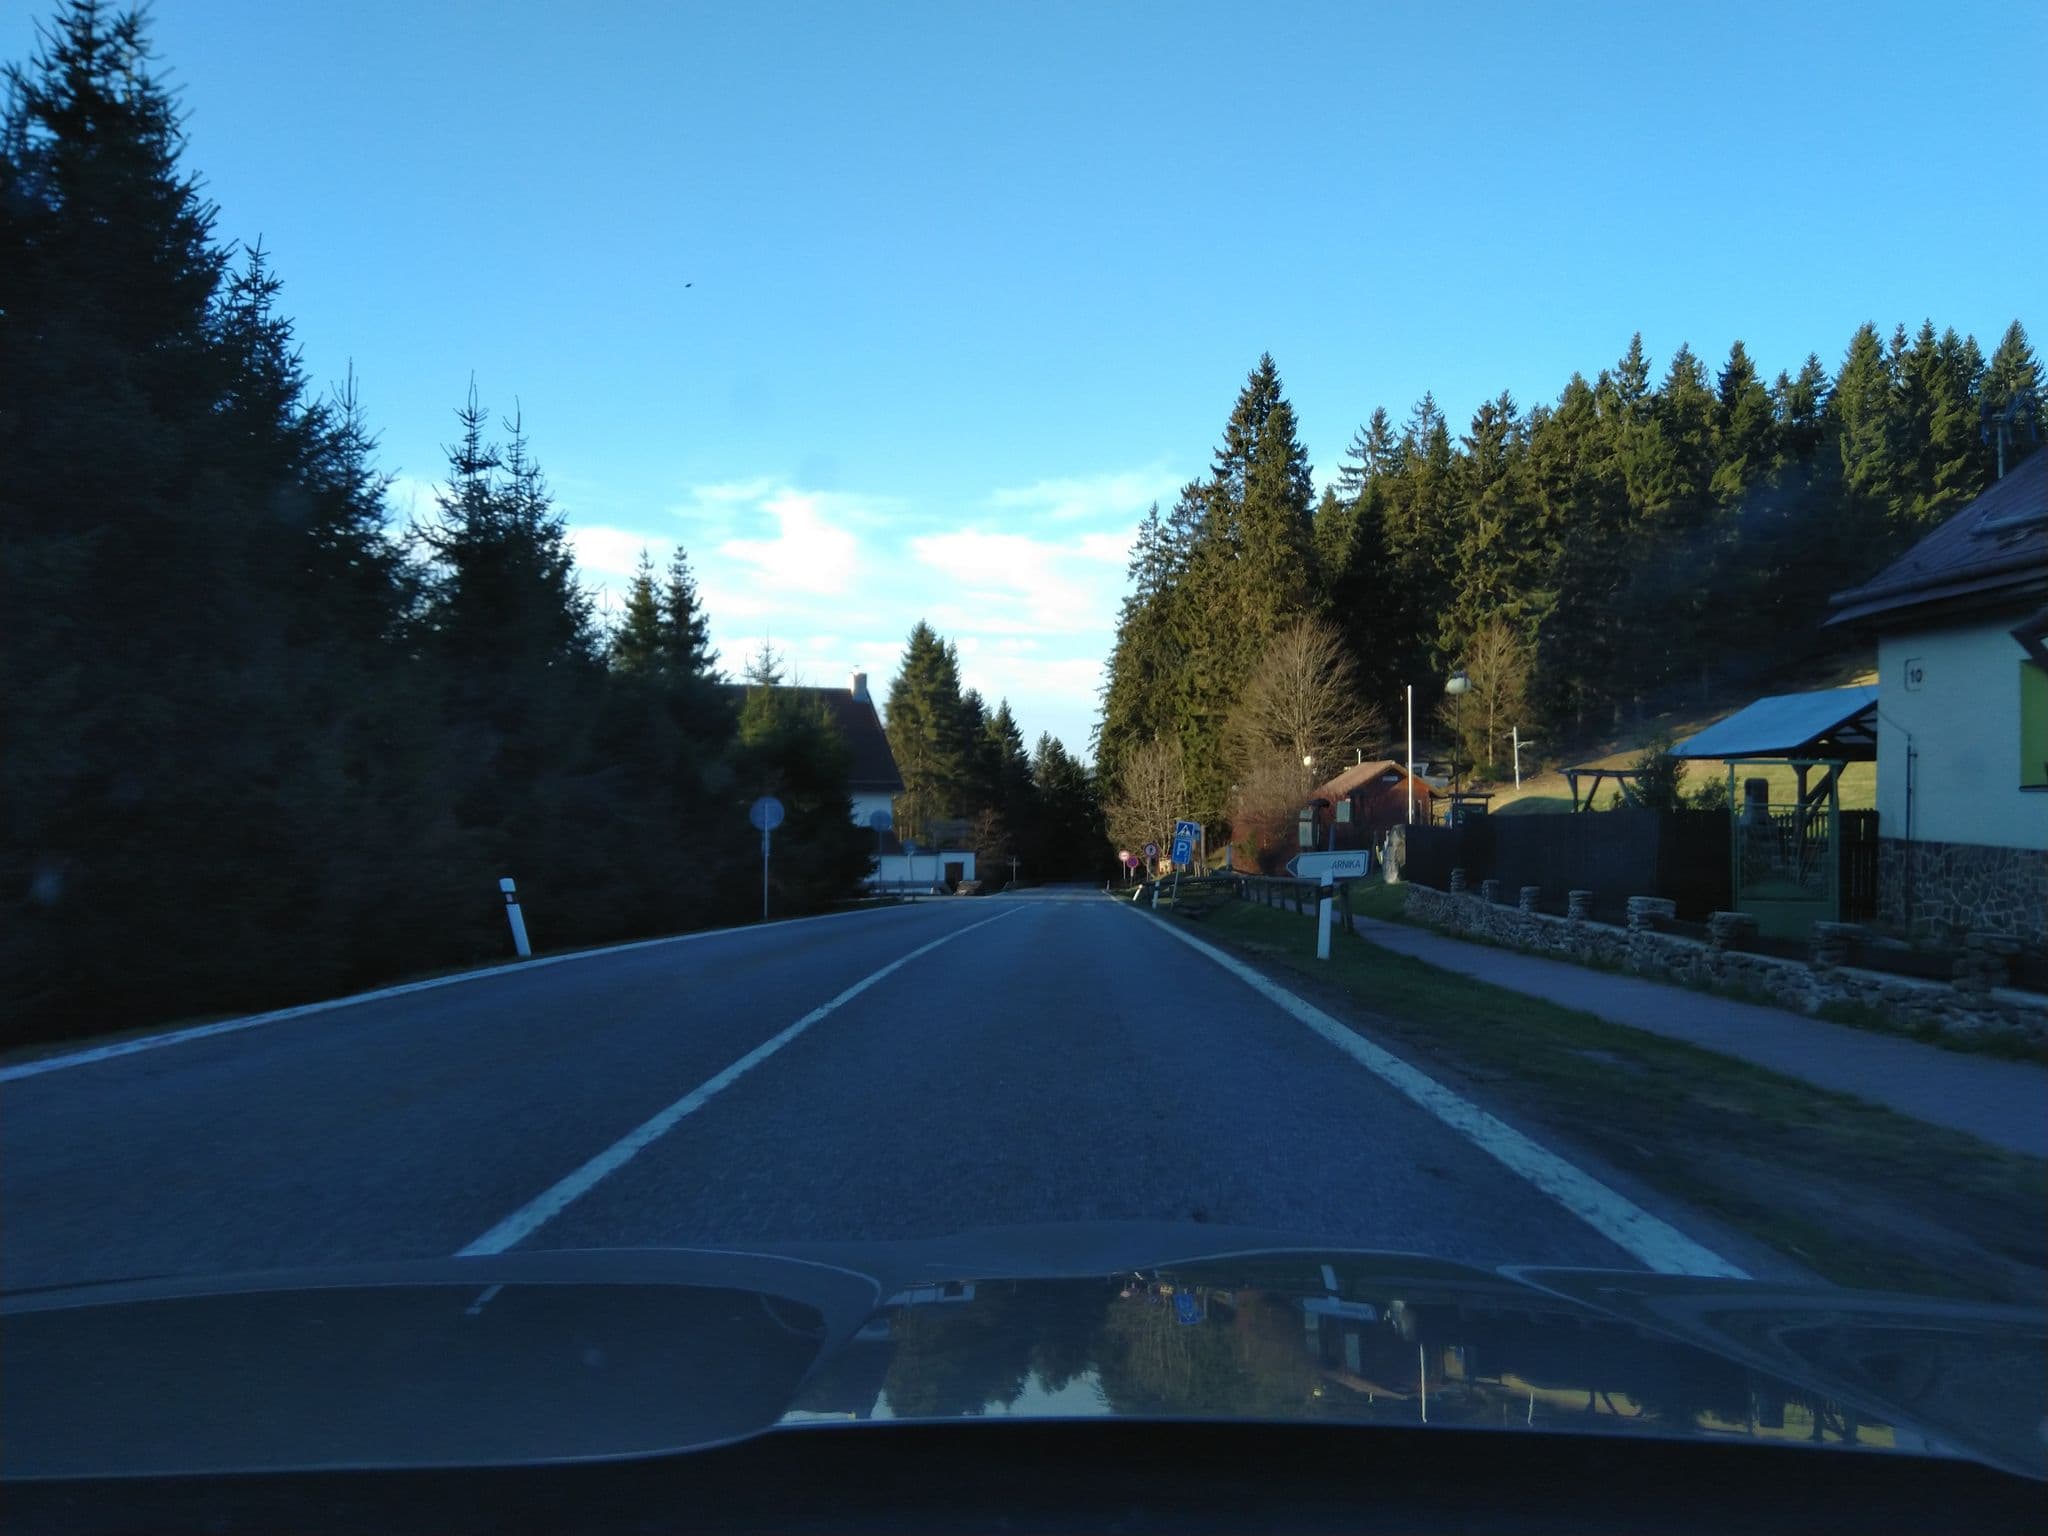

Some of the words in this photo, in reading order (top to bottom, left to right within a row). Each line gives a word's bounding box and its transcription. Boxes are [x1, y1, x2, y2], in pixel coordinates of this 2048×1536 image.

[1910, 669, 1923, 683] 10
[1176, 842, 1188, 856] P
[1331, 860, 1361, 870] ARNIKA
